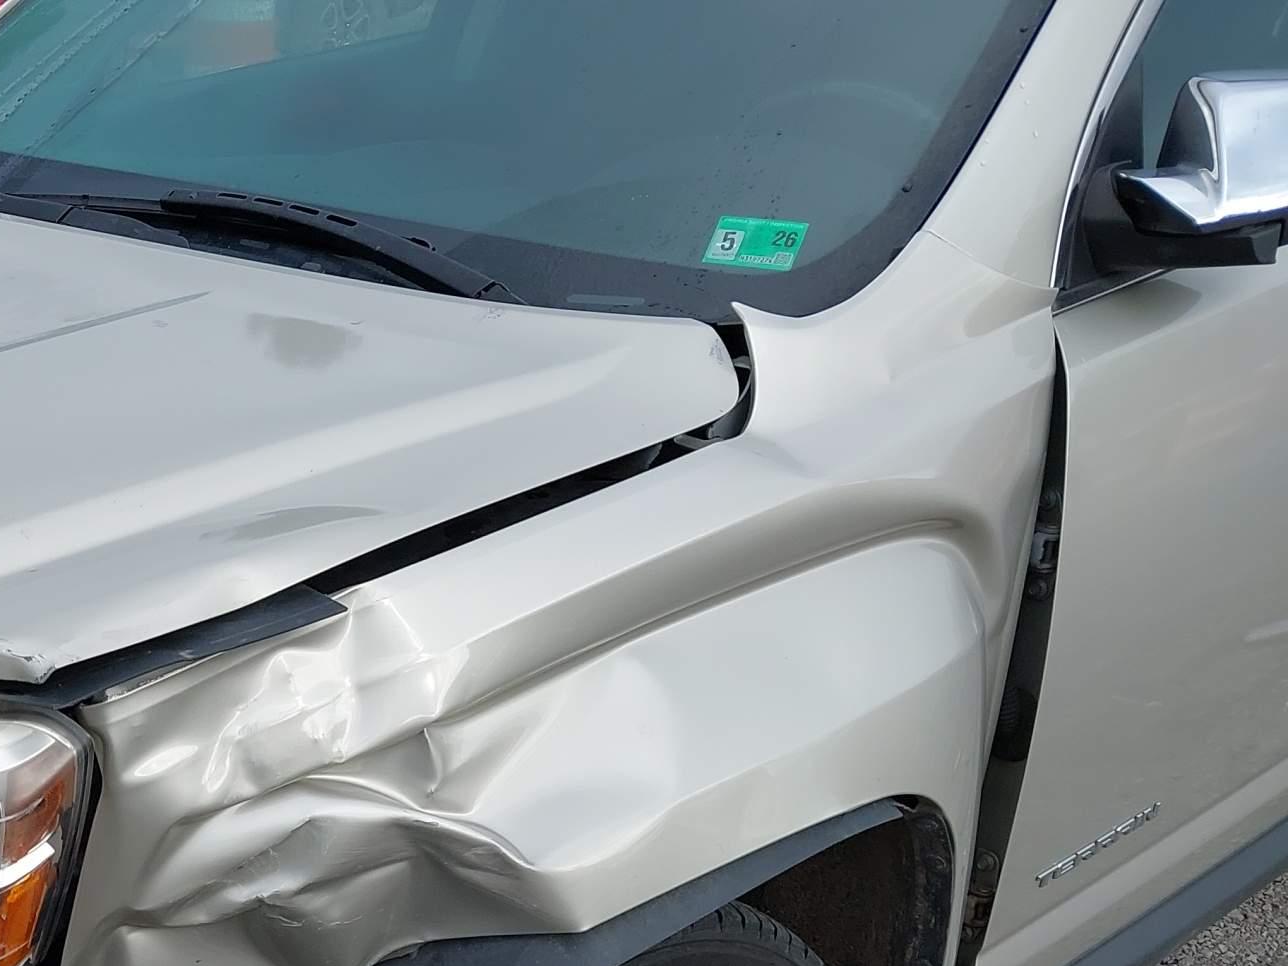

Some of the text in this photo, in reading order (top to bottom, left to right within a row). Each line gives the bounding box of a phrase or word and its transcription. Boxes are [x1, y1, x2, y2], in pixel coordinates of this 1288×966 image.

[720, 231, 737, 251] 5
[771, 230, 799, 248] 26
[1034, 800, 1161, 888] TERRAIN
